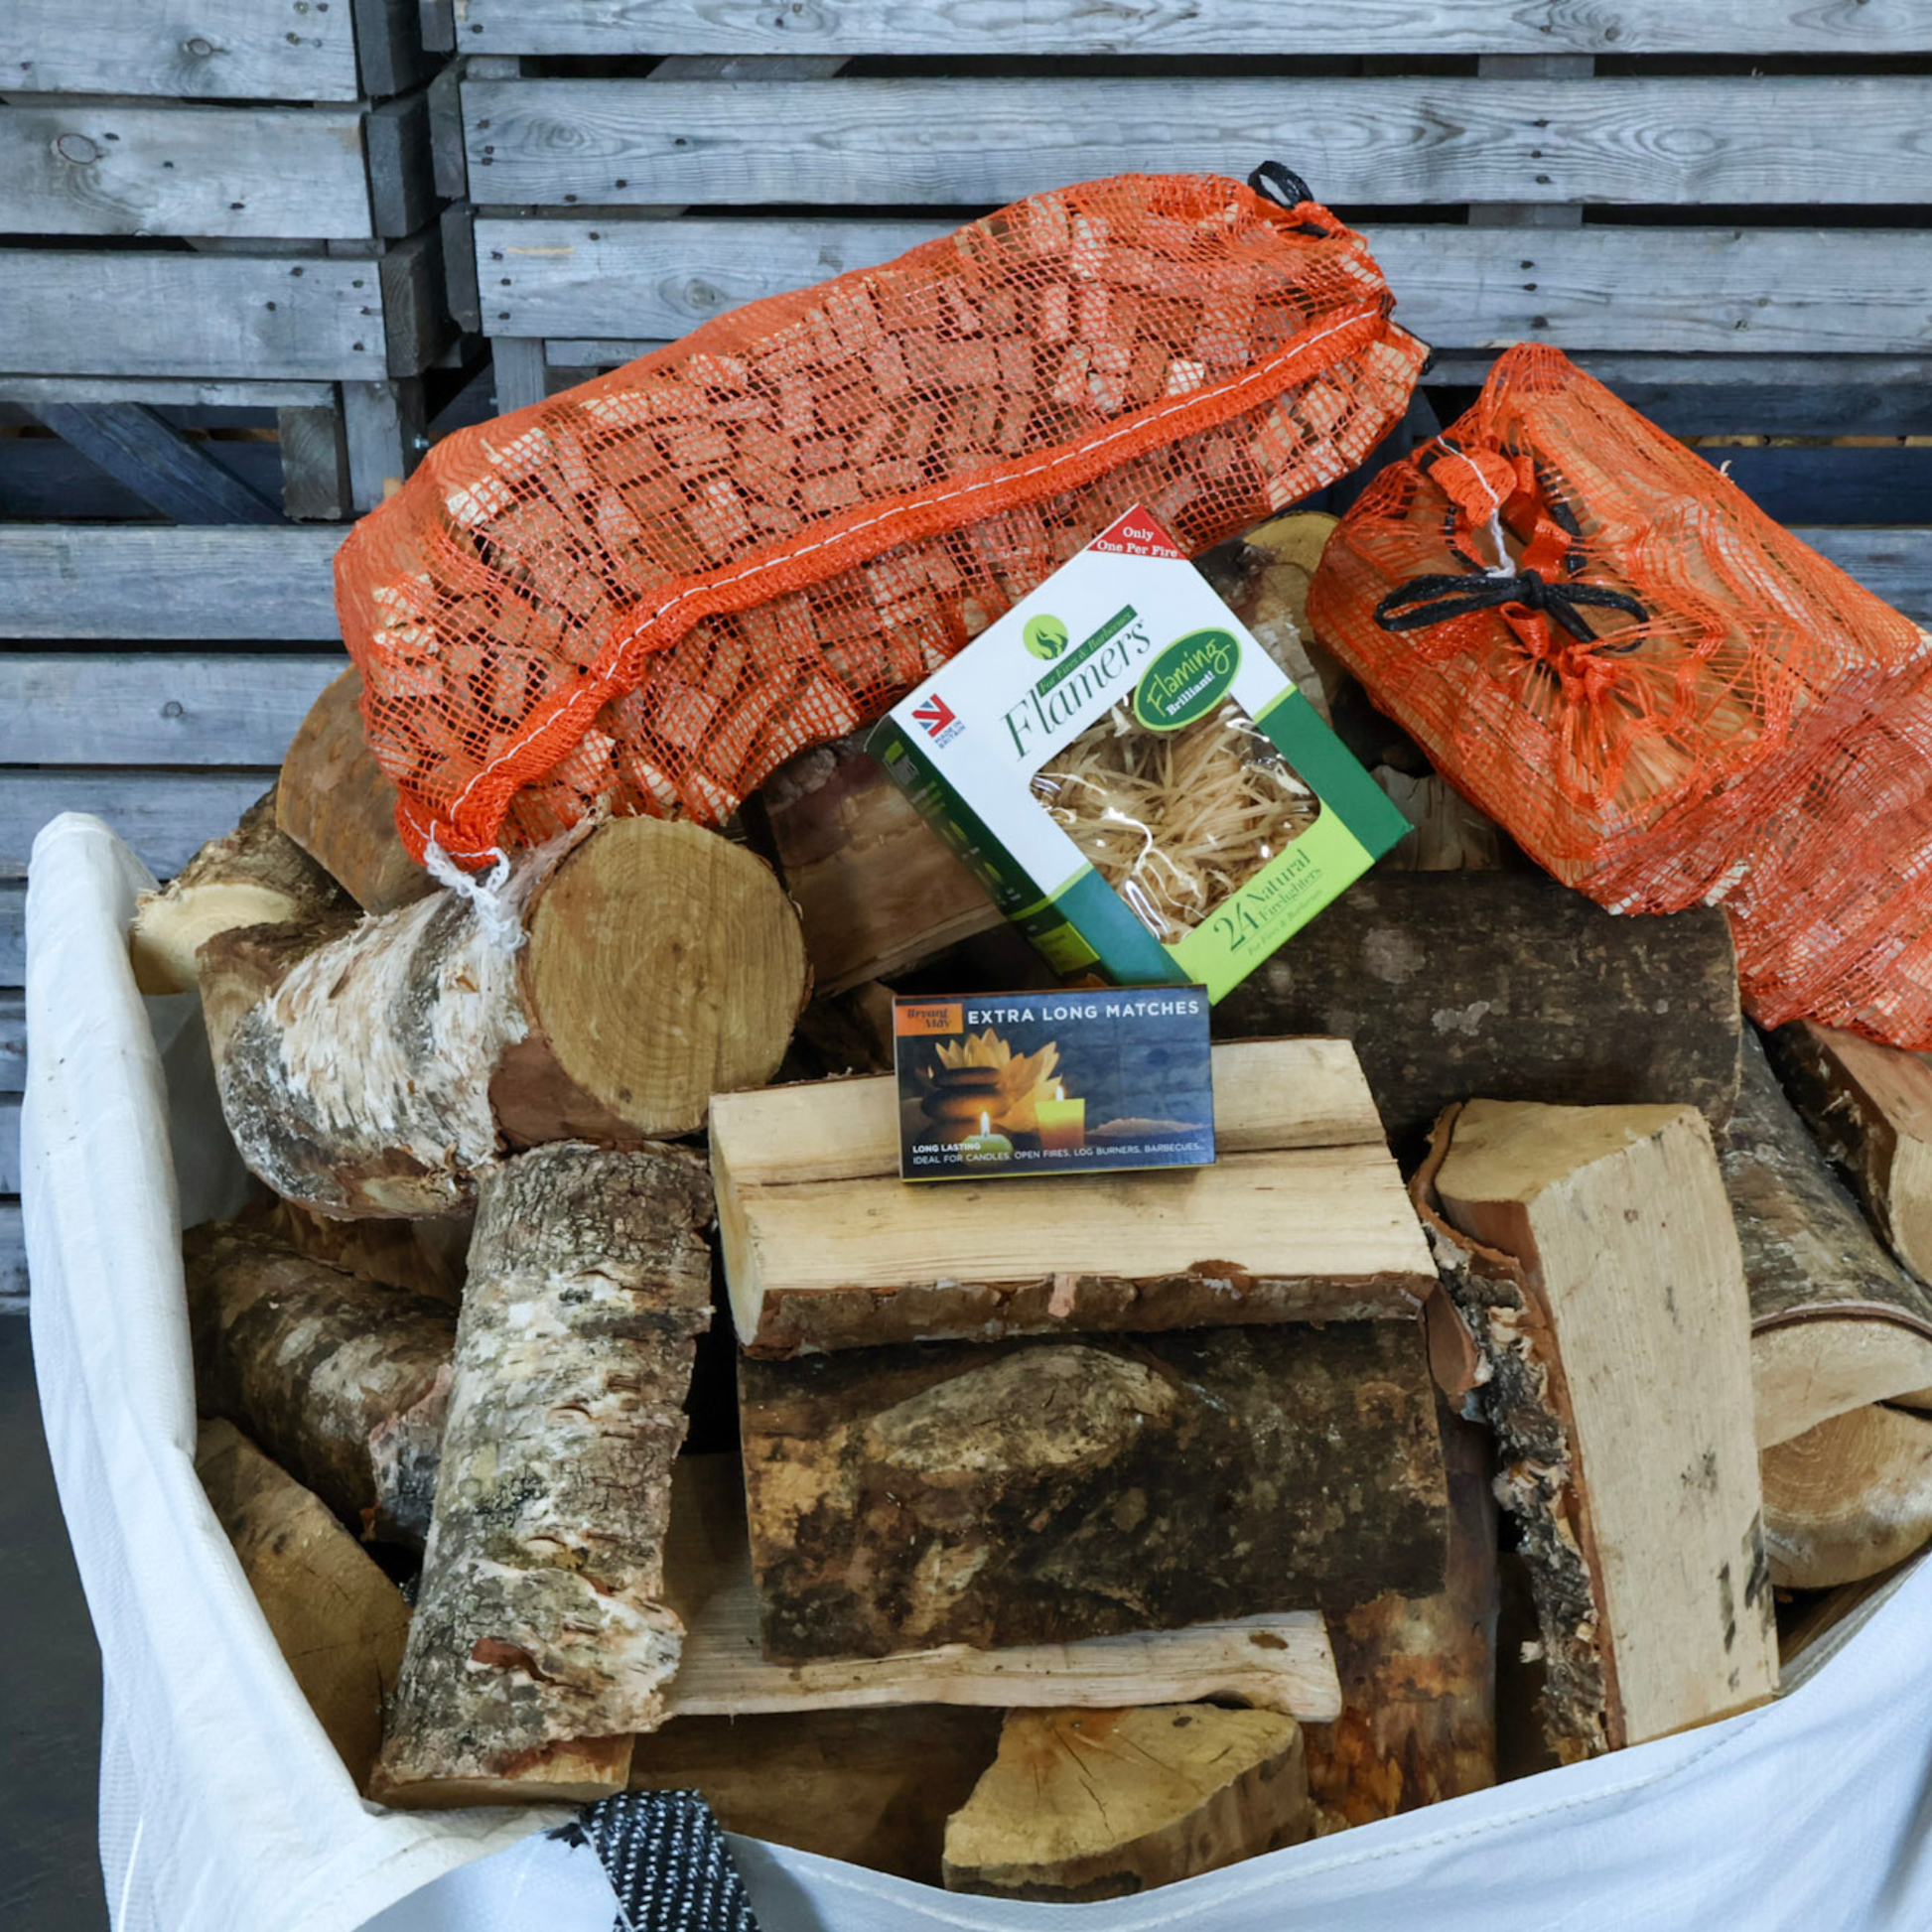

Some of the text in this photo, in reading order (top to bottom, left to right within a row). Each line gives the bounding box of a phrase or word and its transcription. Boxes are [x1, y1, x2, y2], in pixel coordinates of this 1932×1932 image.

[1122, 526, 1154, 542] Only
[1097, 539, 1178, 558] One Per Fire
[1038, 612, 1133, 694] For Fires & Barbecues
[1147, 638, 1231, 718] Flaming
[1000, 621, 1151, 761] Flamers
[1166, 670, 1215, 716] Brilliant!
[934, 720, 963, 745] MADE IN
[938, 725, 966, 749] BRITAIN
[1213, 848, 1311, 951] 24 Natural
[1259, 869, 1321, 922] Firelighters
[967, 1001, 1199, 1025] EXTRA LONG MATCHES
[912, 1142, 981, 1154] LONG LASTING
[913, 1156, 941, 1166] IDEAL
[943, 1154, 963, 1164] FOR
[965, 1152, 1012, 1163] CANDLES,
[1015, 1151, 1040, 1160] OPEN
[1042, 1148, 1071, 1159] FIRES,
[1074, 1148, 1094, 1157] LOG
[1096, 1146, 1142, 1156] BURNERS,
